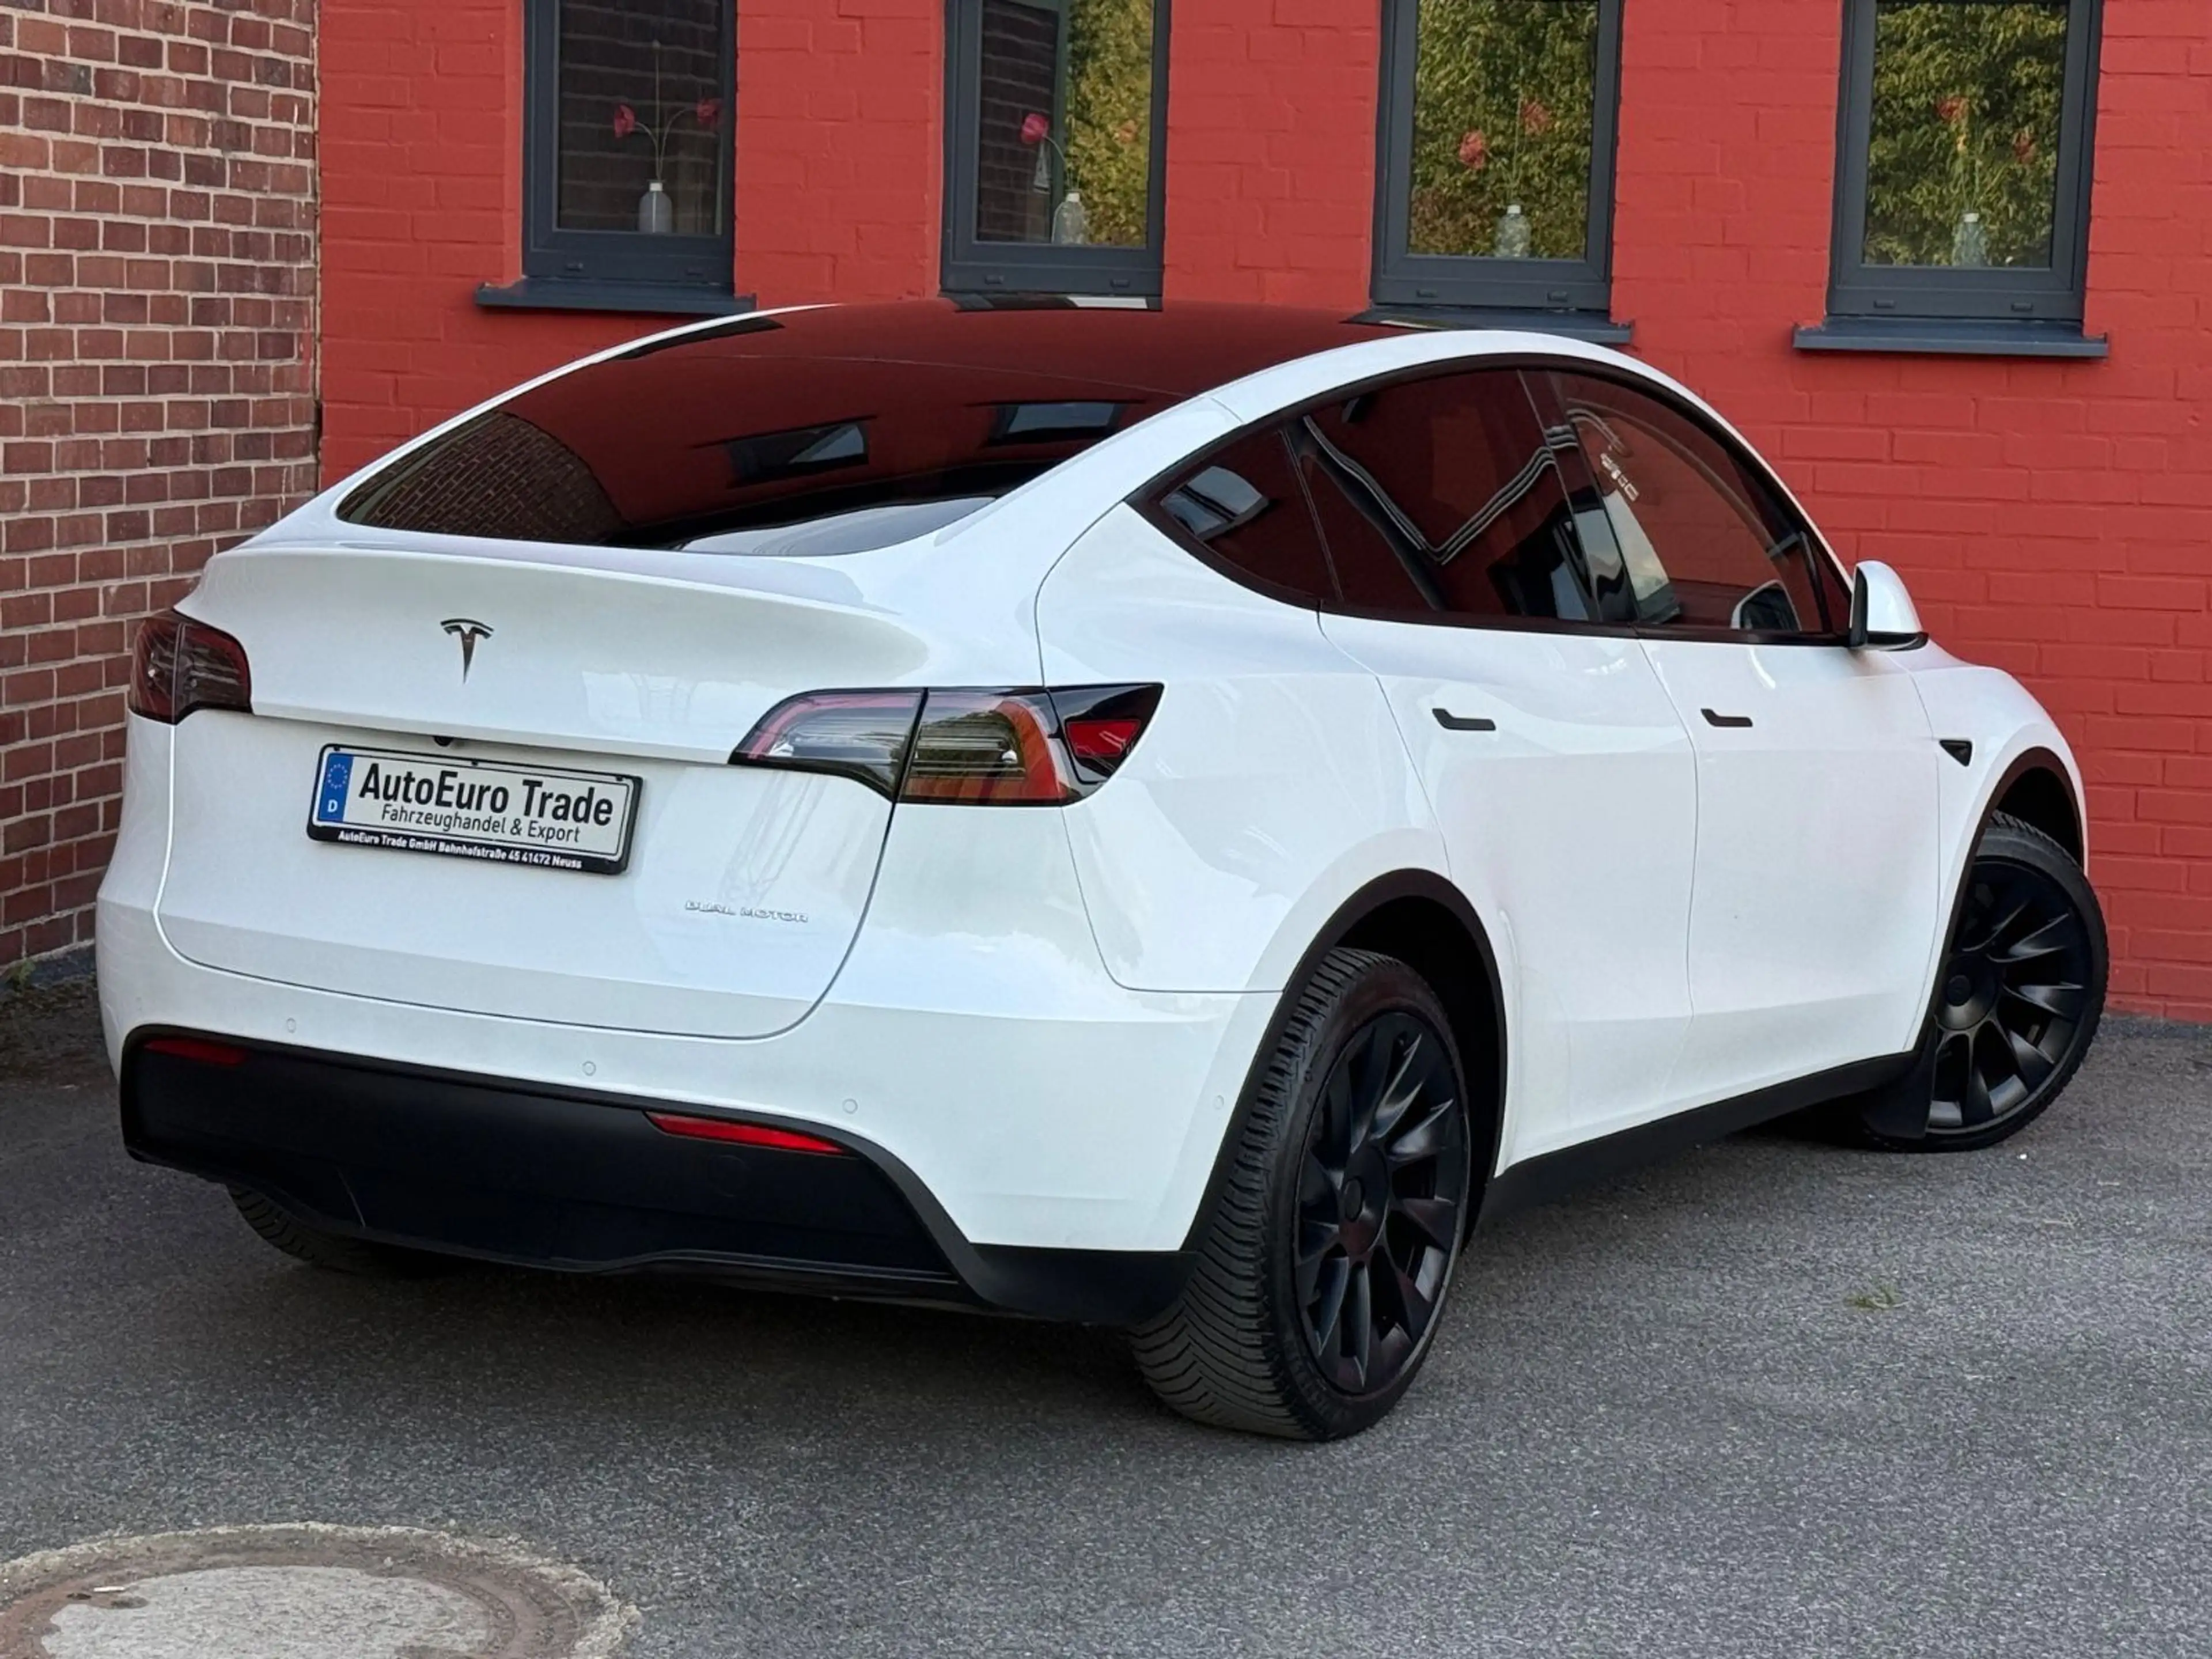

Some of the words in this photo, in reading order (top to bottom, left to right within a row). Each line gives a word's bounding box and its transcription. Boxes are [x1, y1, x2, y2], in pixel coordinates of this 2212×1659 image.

[327, 800, 338, 813] D
[359, 763, 509, 813] AutoEuro
[522, 779, 613, 826] Trade
[382, 804, 505, 834] Fahrzeughandel
[509, 819, 523, 835] &
[528, 820, 580, 843] Export
[338, 830, 380, 844] AutoEuro
[381, 835, 407, 847] Trade
[408, 838, 437, 851] GmbH
[508, 850, 521, 862] 45
[521, 852, 551, 865] 41472
[551, 855, 582, 869] Neuss
[740, 907, 808, 923] MOTOR
